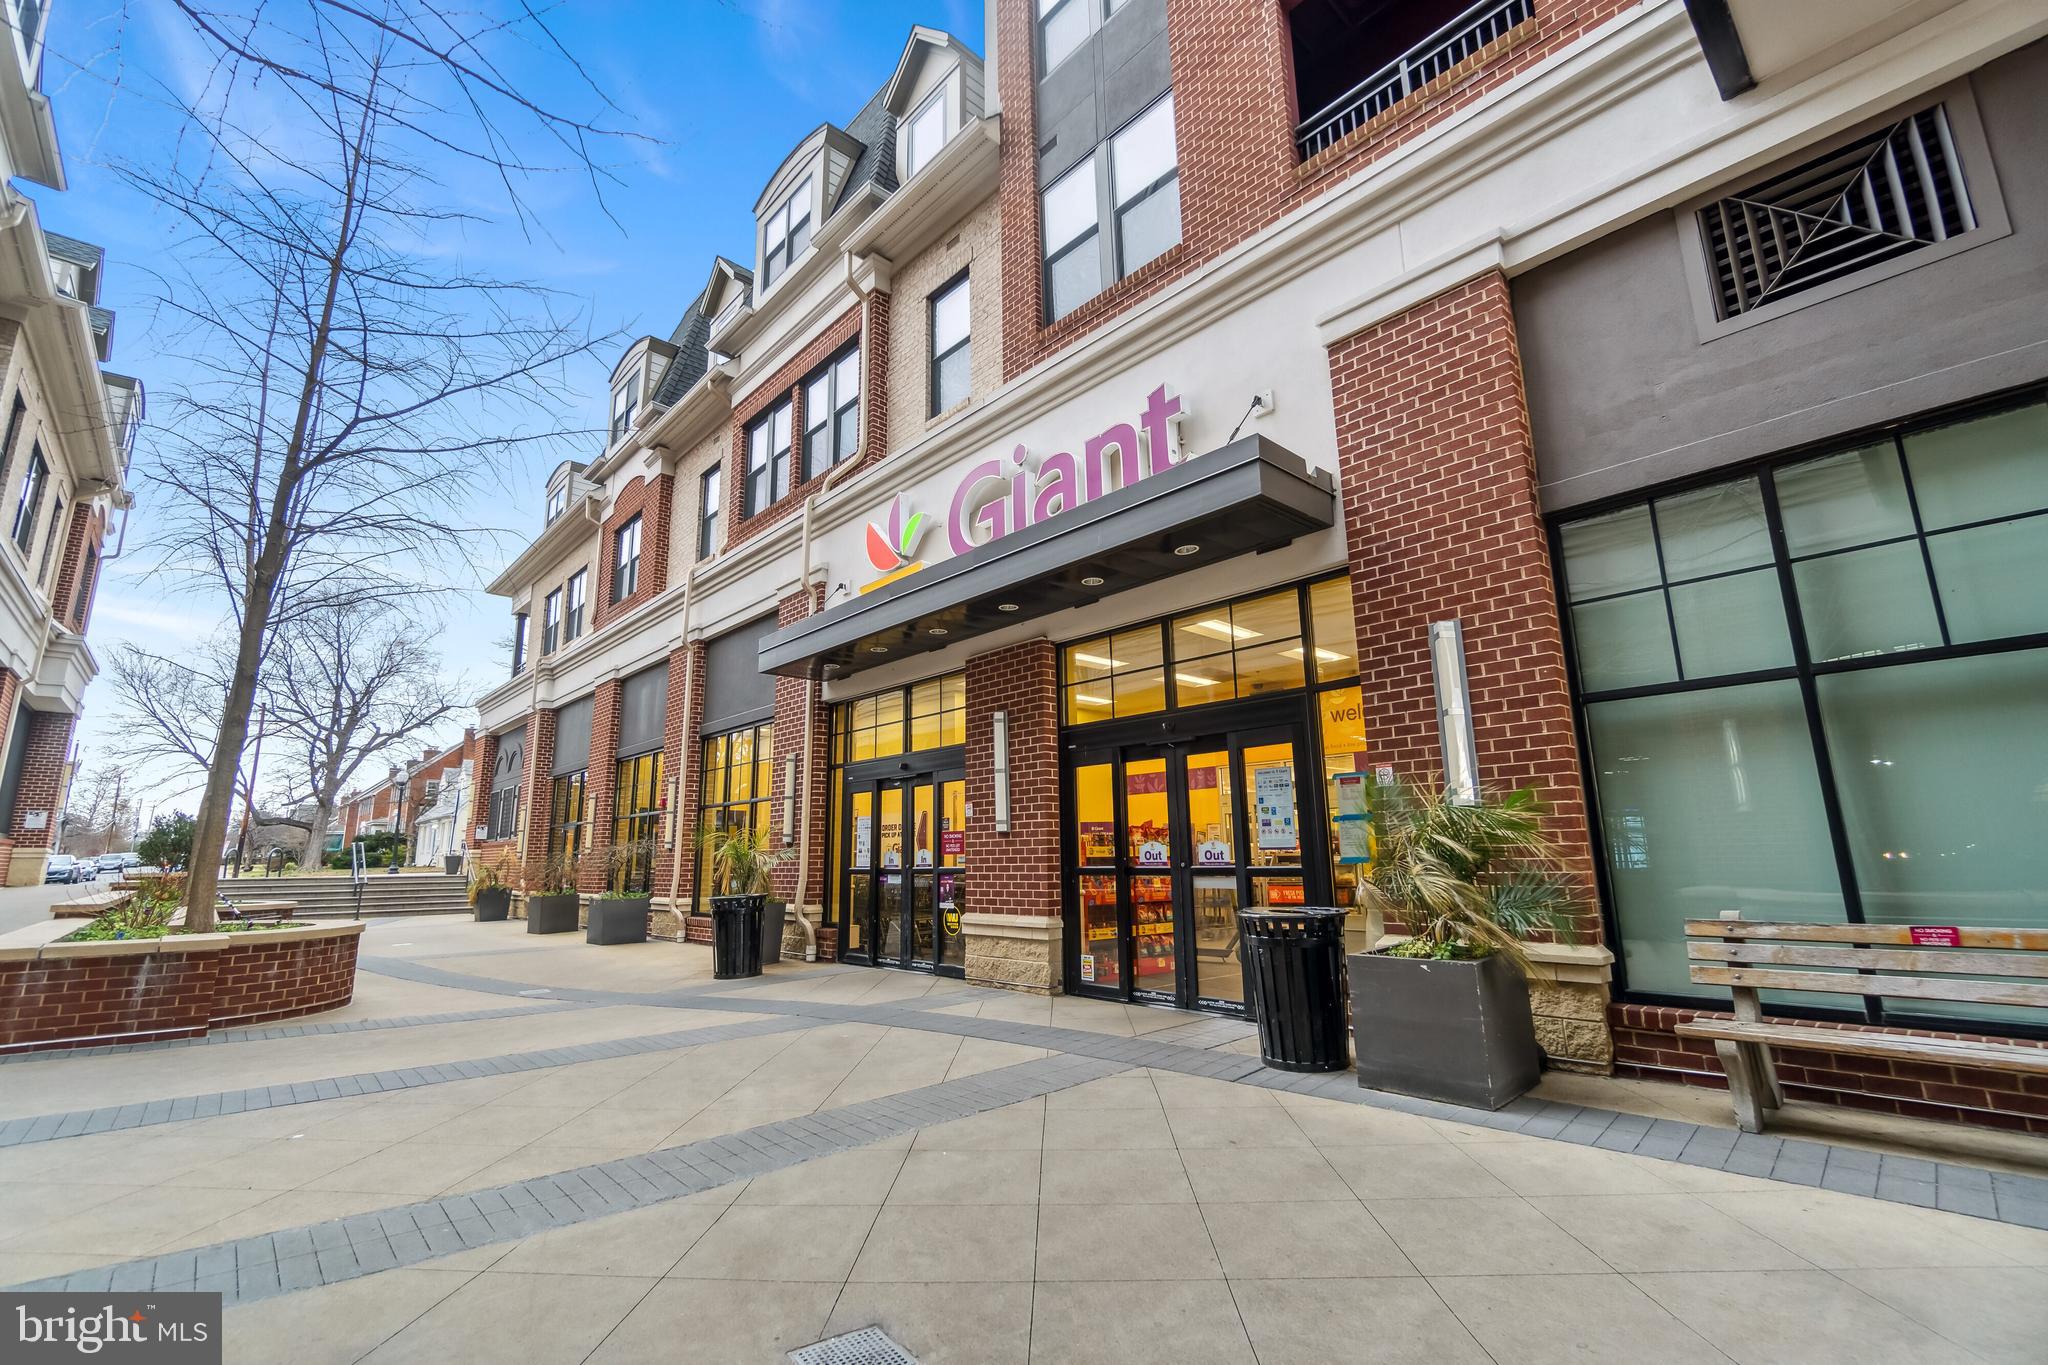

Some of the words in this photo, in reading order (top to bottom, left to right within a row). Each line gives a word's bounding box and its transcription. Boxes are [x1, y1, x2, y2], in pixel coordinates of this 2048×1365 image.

[948, 382, 1187, 556] Giant
[920, 856, 927, 864] In
[1144, 850, 1162, 861] Out
[1204, 849, 1225, 861] Out
